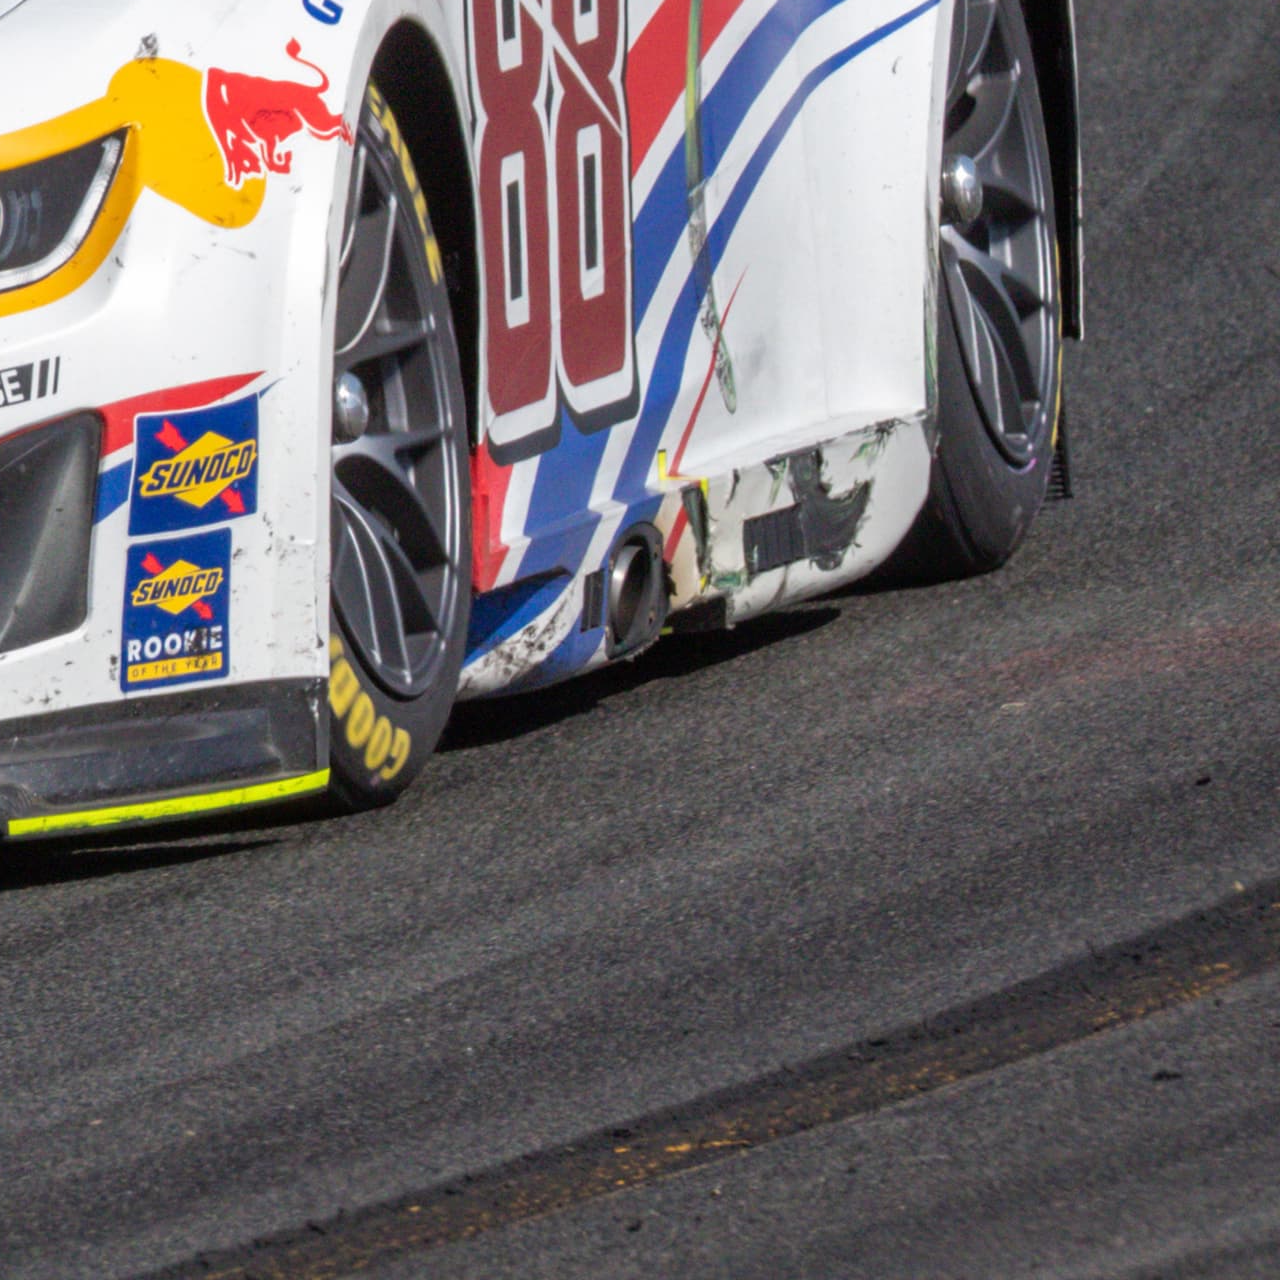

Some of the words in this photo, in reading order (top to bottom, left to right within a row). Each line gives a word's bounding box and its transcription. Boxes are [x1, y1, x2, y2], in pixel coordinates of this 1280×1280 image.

[146, 443, 254, 493] SUNOCO
[135, 570, 220, 604] SUNOCO
[127, 626, 223, 661] ROOKIE
[132, 667, 147, 678] OF
[155, 663, 177, 674] THE
[186, 657, 218, 671] YEAR
